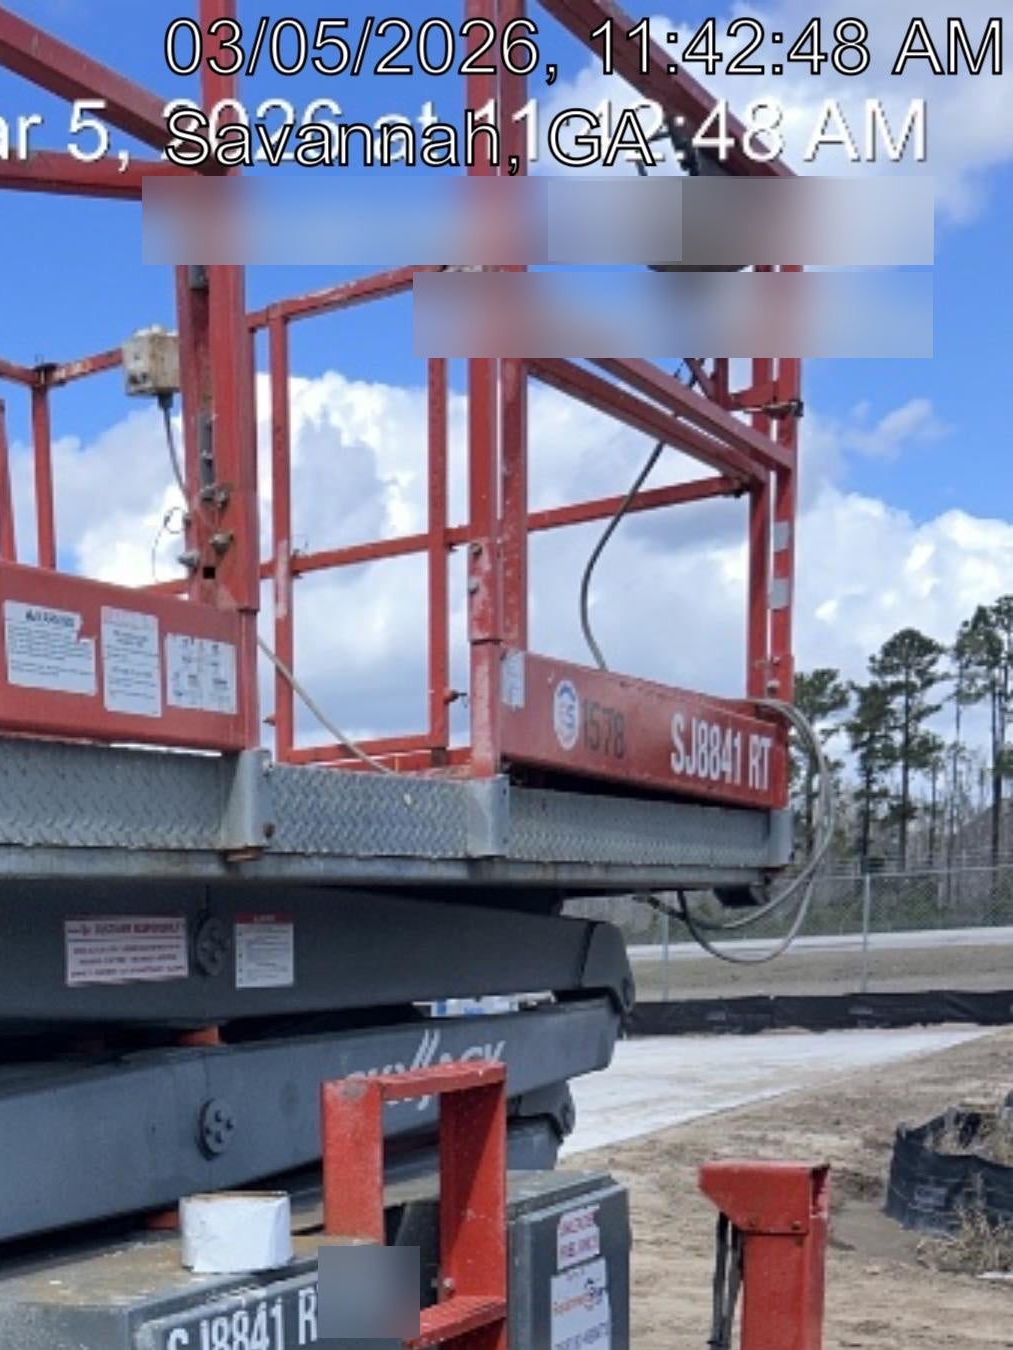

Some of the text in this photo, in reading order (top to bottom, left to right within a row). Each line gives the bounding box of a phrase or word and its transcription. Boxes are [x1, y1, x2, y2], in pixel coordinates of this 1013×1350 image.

[670, 712, 772, 791] SJ8841 RT
[299, 1281, 318, 1345] R
